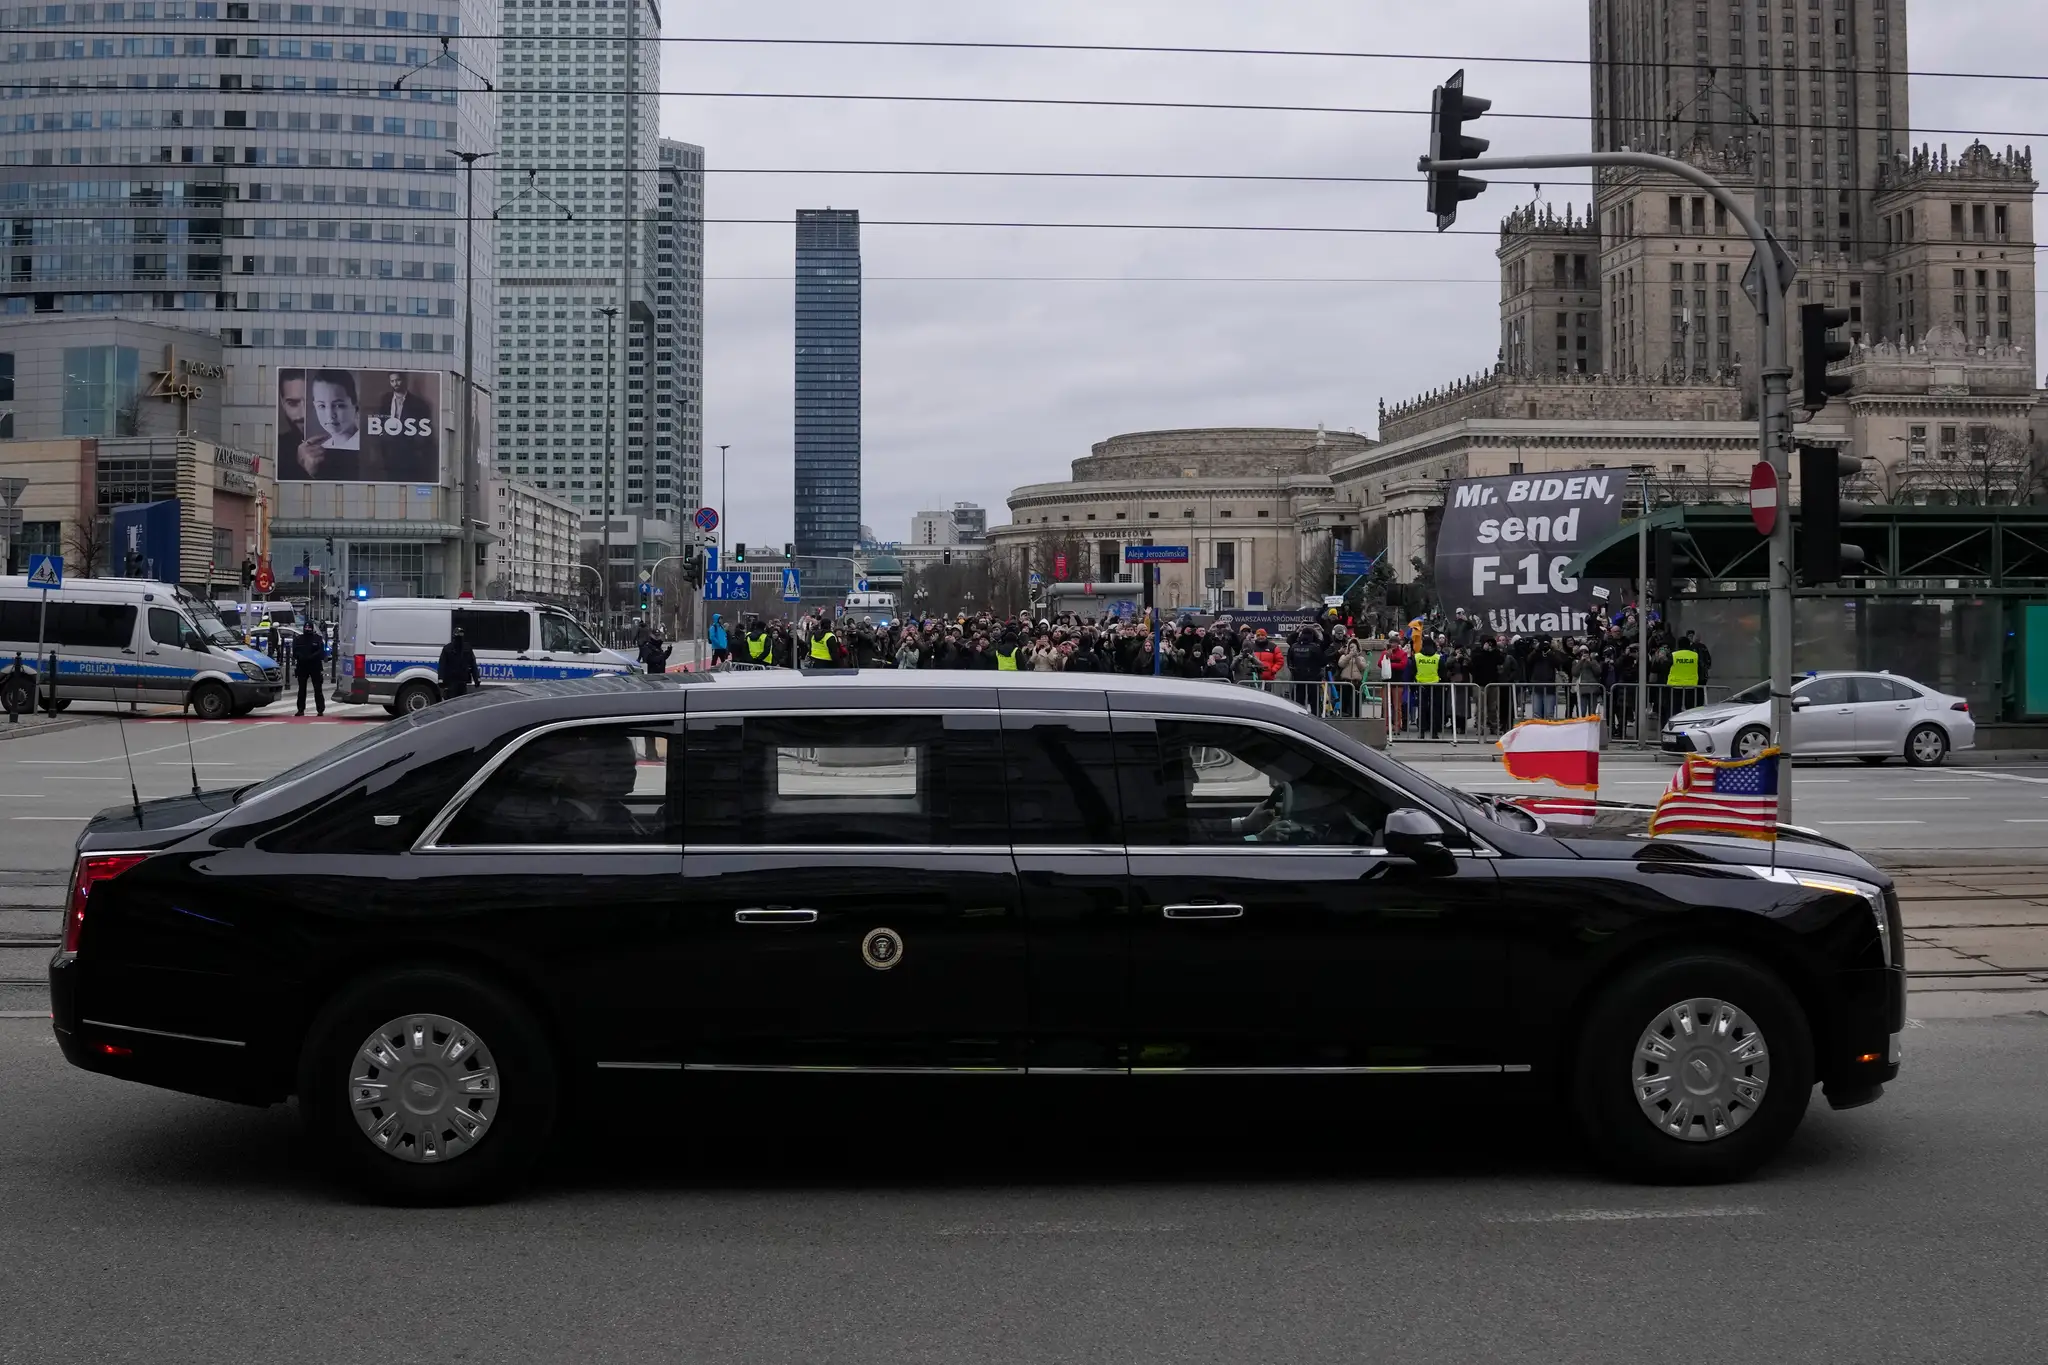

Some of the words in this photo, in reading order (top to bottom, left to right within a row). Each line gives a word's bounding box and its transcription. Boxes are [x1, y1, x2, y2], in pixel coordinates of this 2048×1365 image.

[181, 360, 228, 379] TARASY
[367, 416, 432, 437] BOSS
[1454, 484, 1499, 508] Mr.
[1506, 476, 1615, 505] BIDEN,
[1476, 508, 1580, 544] send
[1127, 550, 1144, 559] Aleje
[1146, 550, 1186, 559] Jerozolimskie
[1472, 553, 1578, 596] F-16
[1488, 606, 1590, 633] Ukrain
[80, 663, 116, 674] POLICJA
[370, 663, 392, 673] U724
[477, 666, 515, 677] OLICJA
